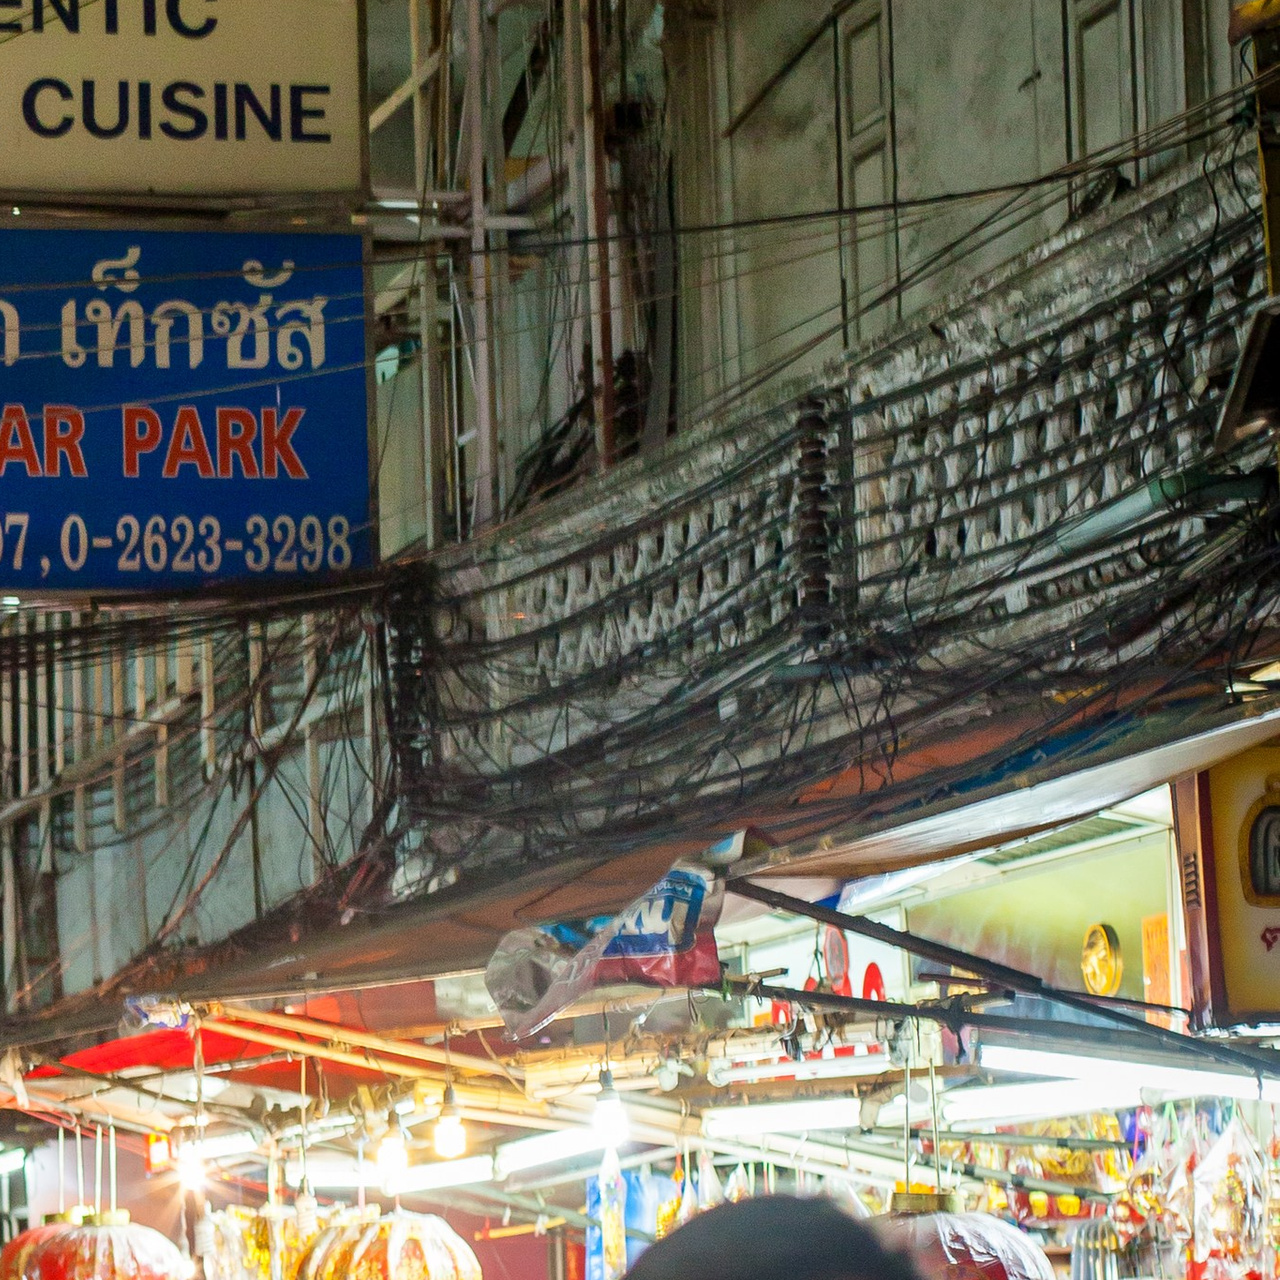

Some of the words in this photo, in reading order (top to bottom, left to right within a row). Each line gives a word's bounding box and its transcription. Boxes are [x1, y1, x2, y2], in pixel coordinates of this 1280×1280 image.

[21, 77, 333, 143] CUISINE
[61, 245, 329, 372] เท็กซัส
[122, 404, 310, 480] PARK
